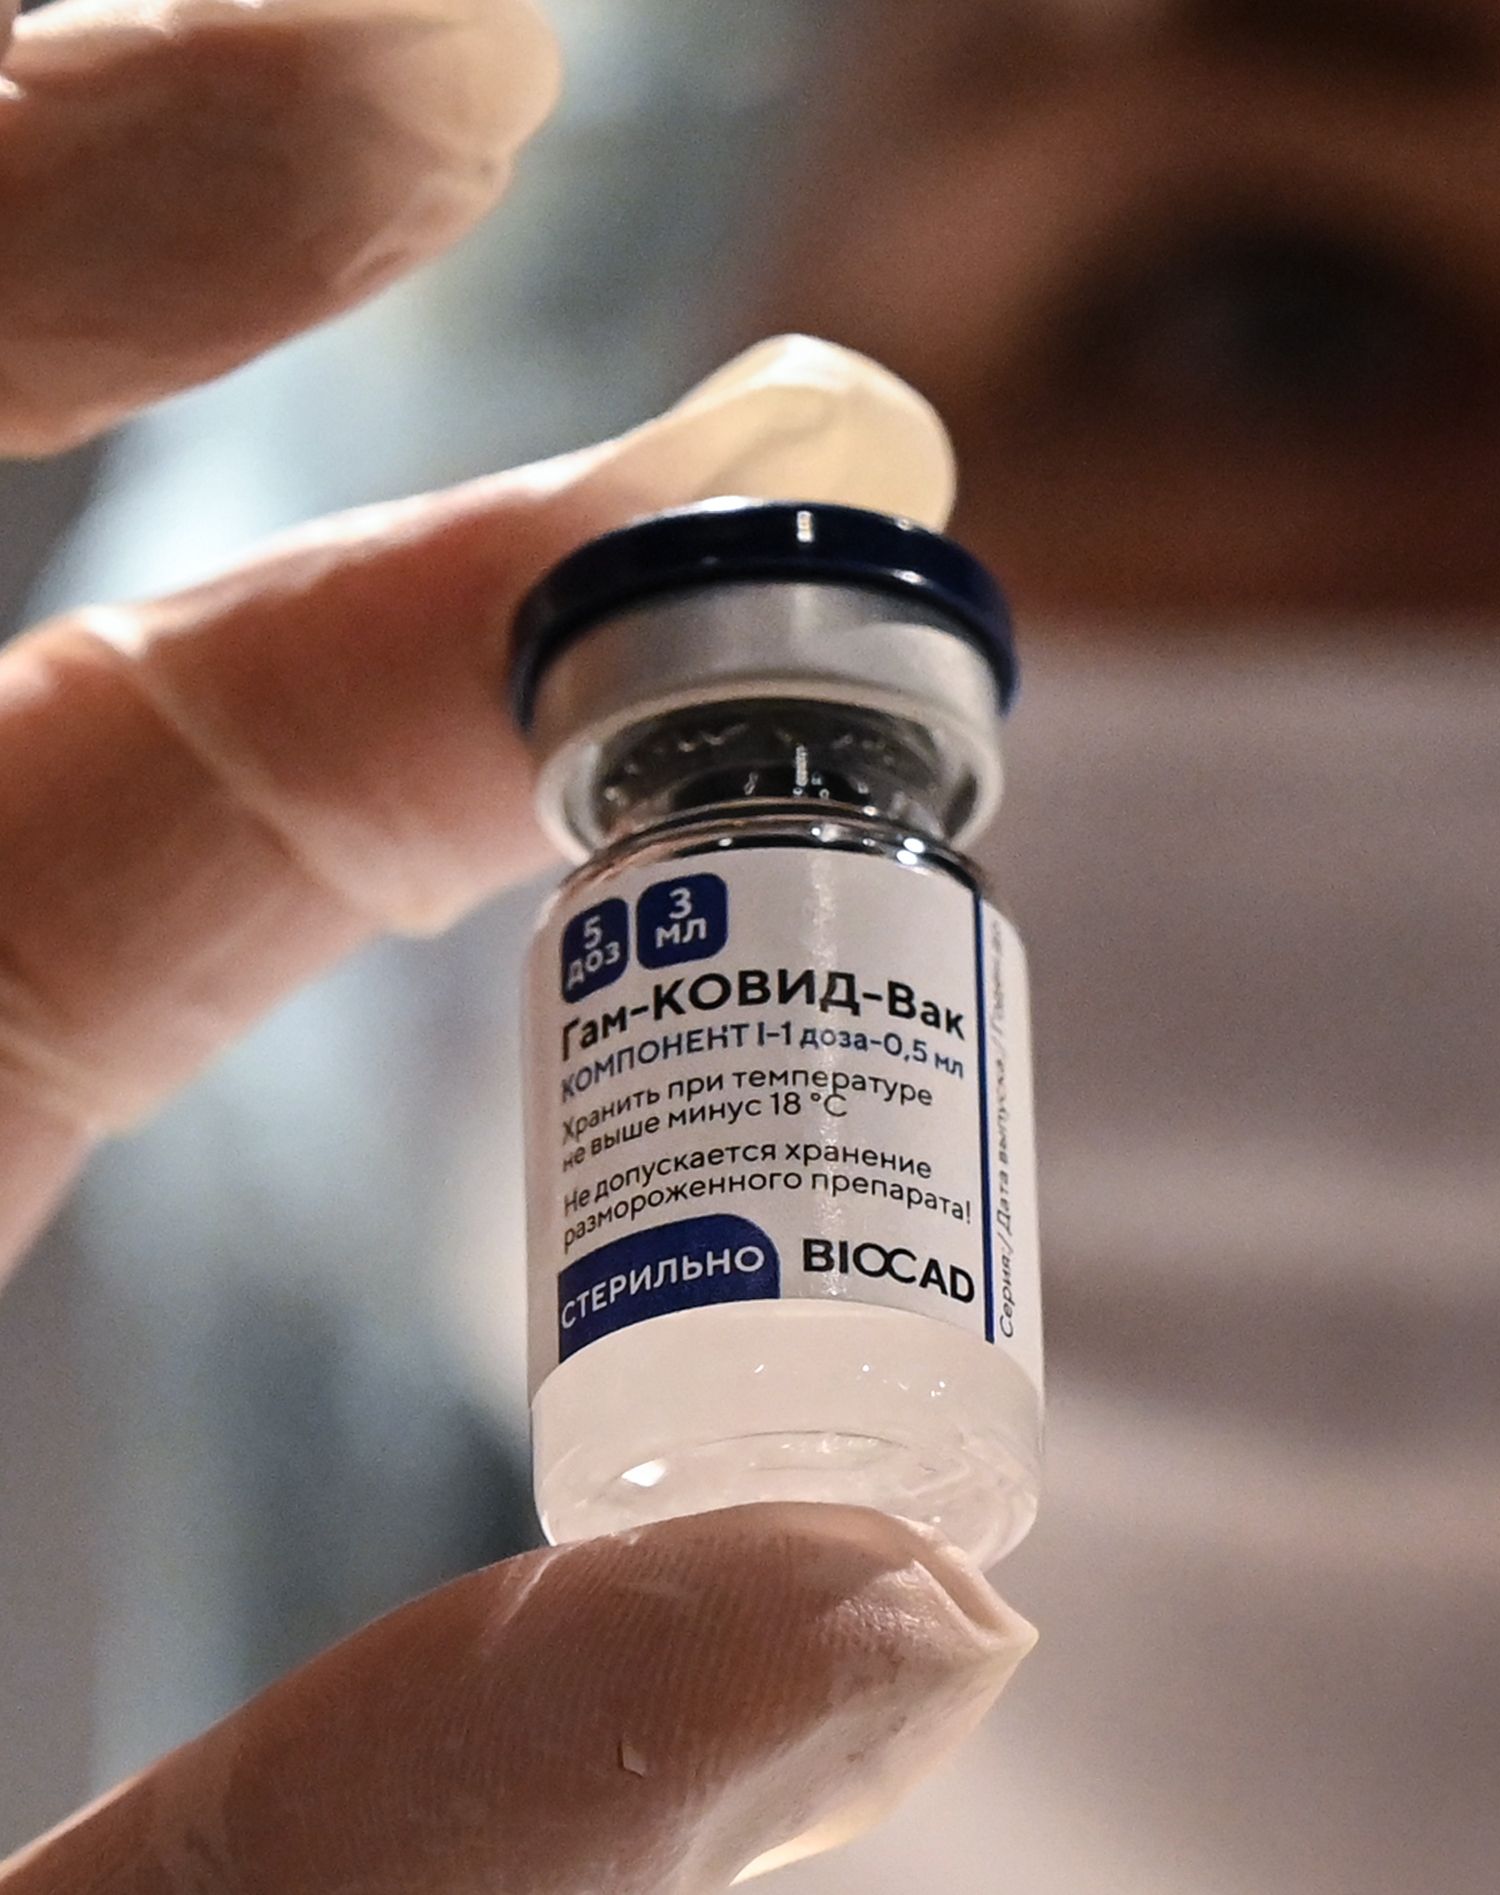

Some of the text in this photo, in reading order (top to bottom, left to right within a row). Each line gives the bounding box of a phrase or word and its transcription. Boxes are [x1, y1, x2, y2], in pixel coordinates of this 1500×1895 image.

[584, 915, 603, 950] 5
[656, 918, 707, 948] мл
[669, 887, 692, 919] 3
[567, 941, 620, 991] доз
[562, 969, 966, 1061] Гам-КОВИД-Вак
[561, 1024, 749, 1103] КОМПОНЕНТ
[934, 1055, 964, 1080] мл
[562, 1069, 933, 1146] Хранить при температуре
[562, 1146, 585, 1172] не
[591, 1116, 660, 1156] выше
[668, 1099, 762, 1125] минус
[770, 1092, 801, 1116] 18
[564, 1143, 932, 1217] Не допускается хранение
[564, 1172, 971, 1254] размороженного препарата!
[561, 1246, 765, 1329] СТЕРИЛЬНО
[803, 1238, 975, 1304] BIOCAD
